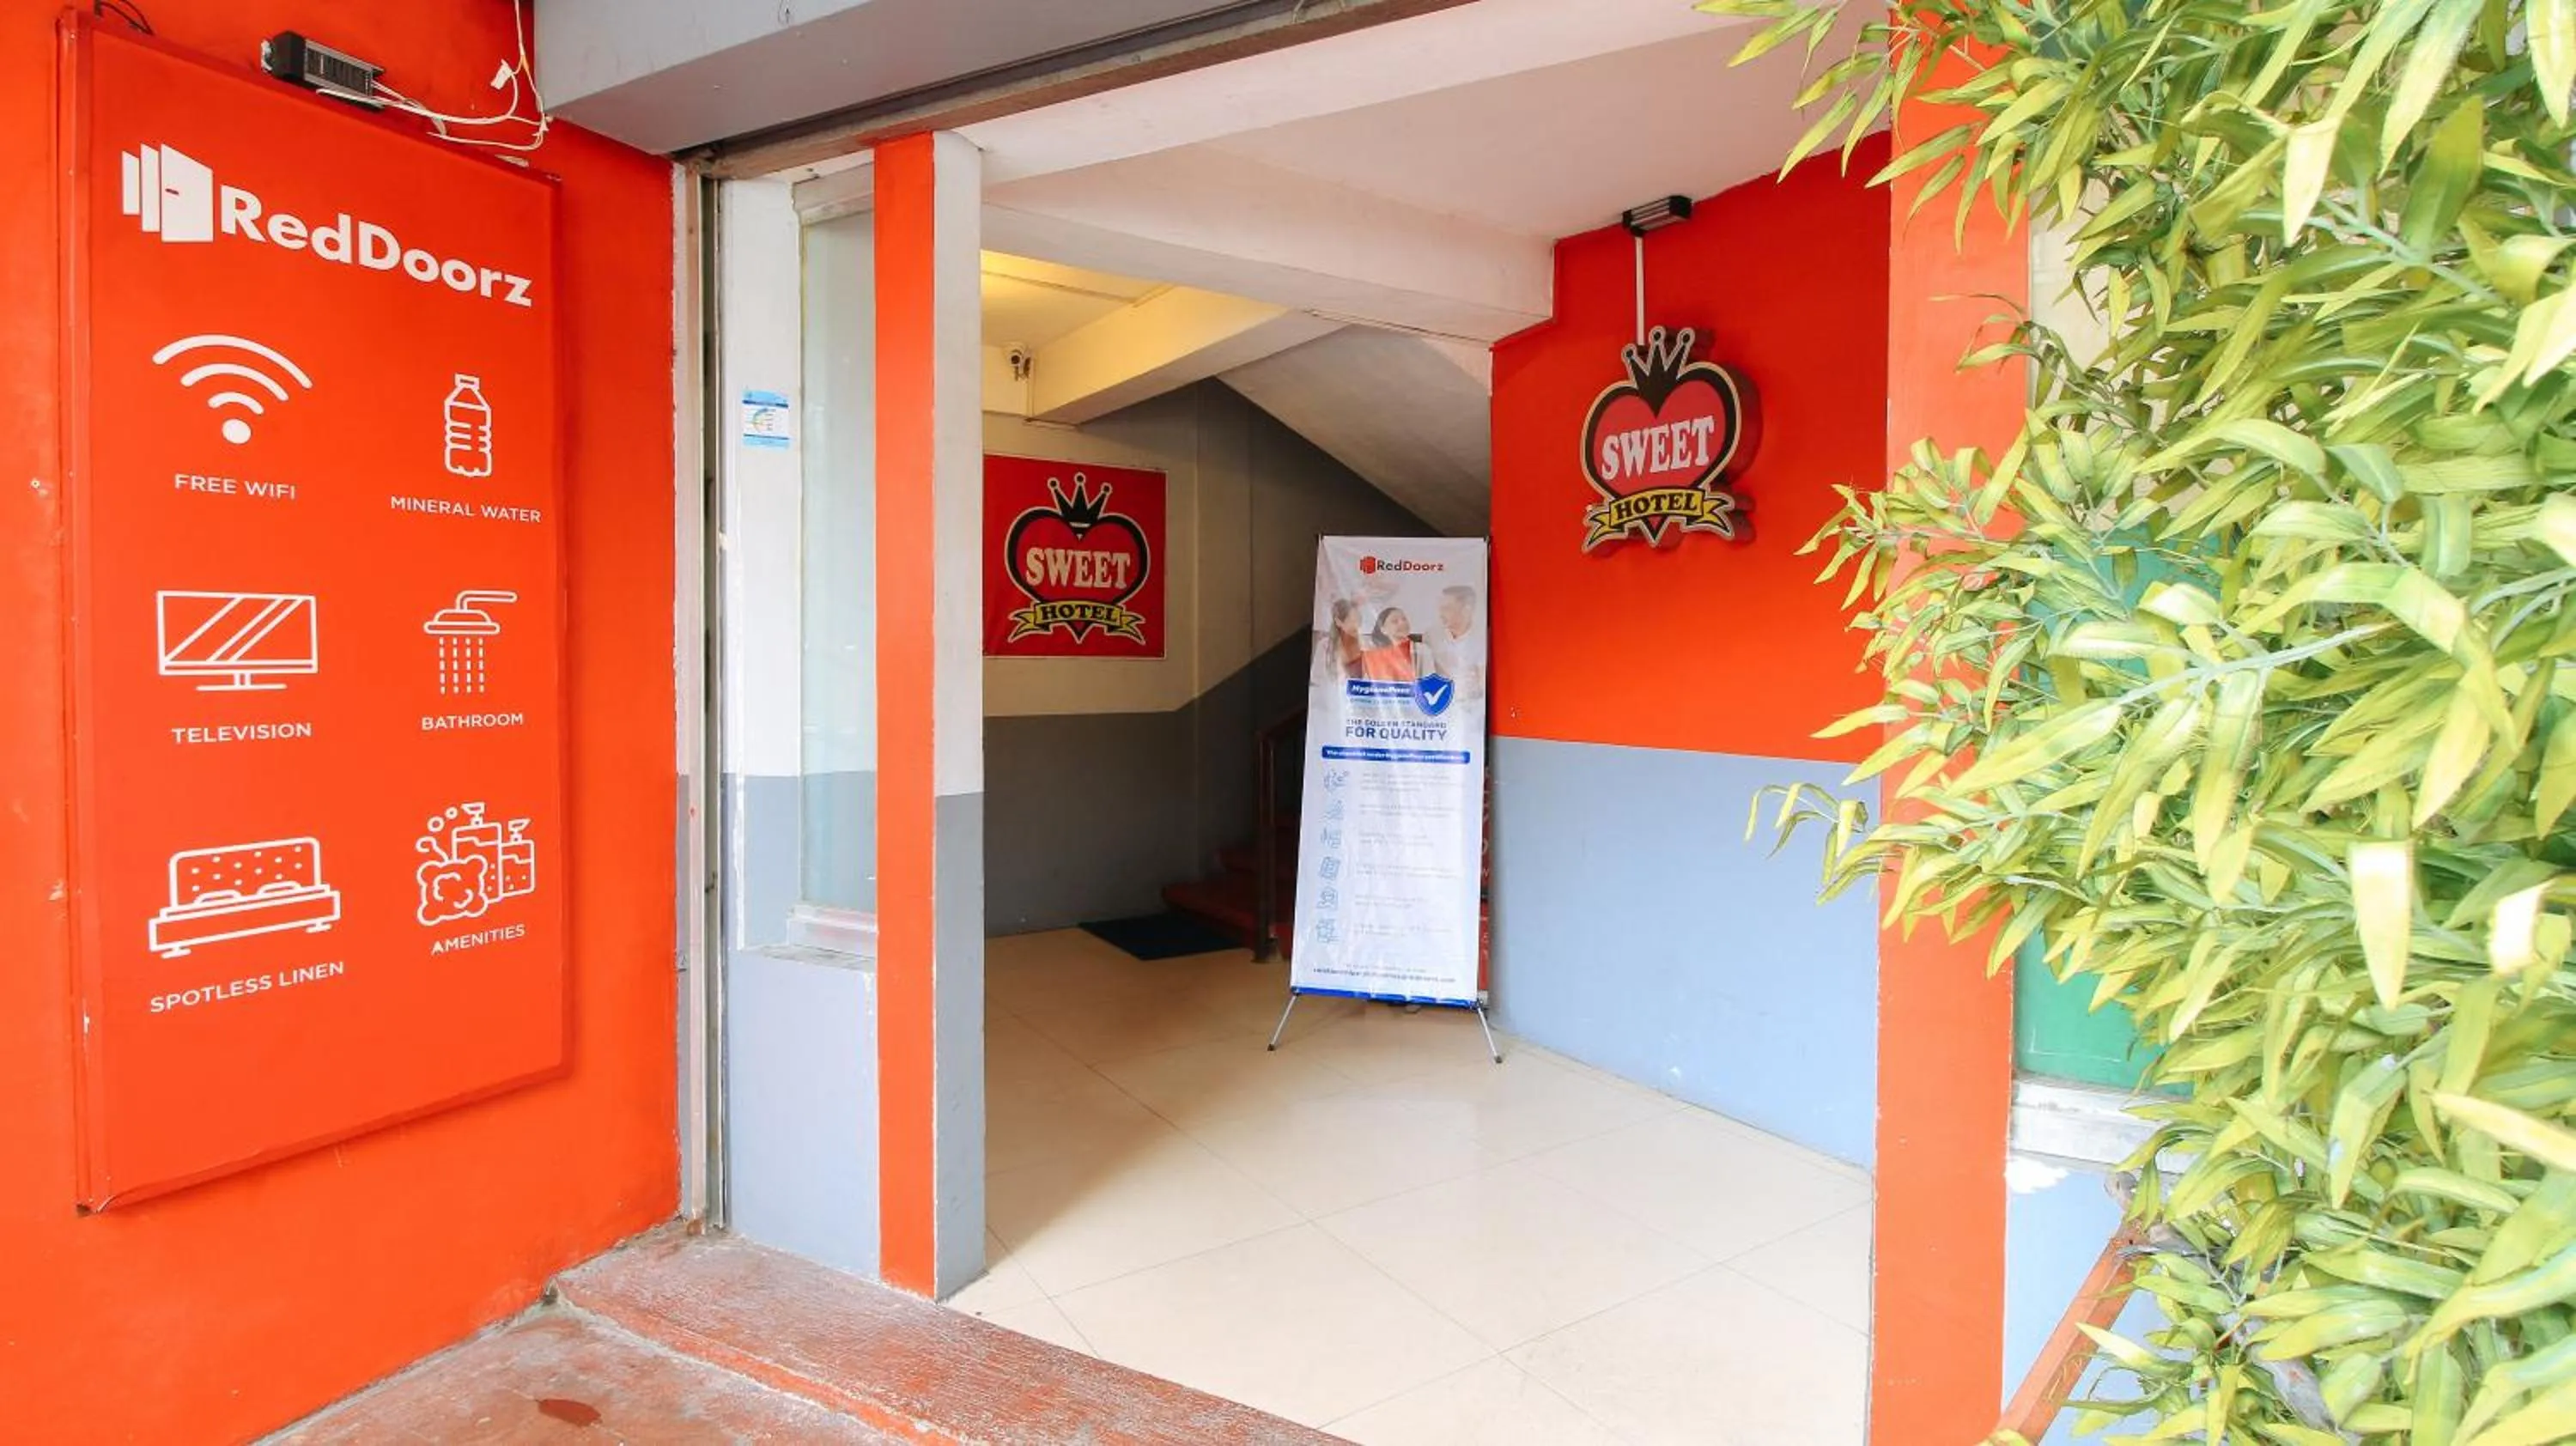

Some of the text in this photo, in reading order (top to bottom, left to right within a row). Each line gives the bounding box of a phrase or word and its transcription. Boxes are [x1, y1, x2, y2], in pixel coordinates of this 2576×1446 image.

[219, 184, 533, 307] RedDoorz
[1601, 416, 1715, 480] SWEET
[174, 473, 296, 500] FREE WIFI
[390, 495, 542, 523] MINERAL WATER
[1615, 493, 1697, 519] HOTEL
[1026, 547, 1130, 588] SWEET
[1376, 559, 1443, 572] RedDoorz
[1041, 604, 1118, 622] HOTEL
[172, 722, 312, 744] TELEVISION
[421, 712, 524, 731] BATHROOM
[1346, 726, 1448, 740] FOR QUALITY
[430, 923, 525, 955] AMENITIES
[149, 961, 343, 1013] SPOTLESS LINEN
